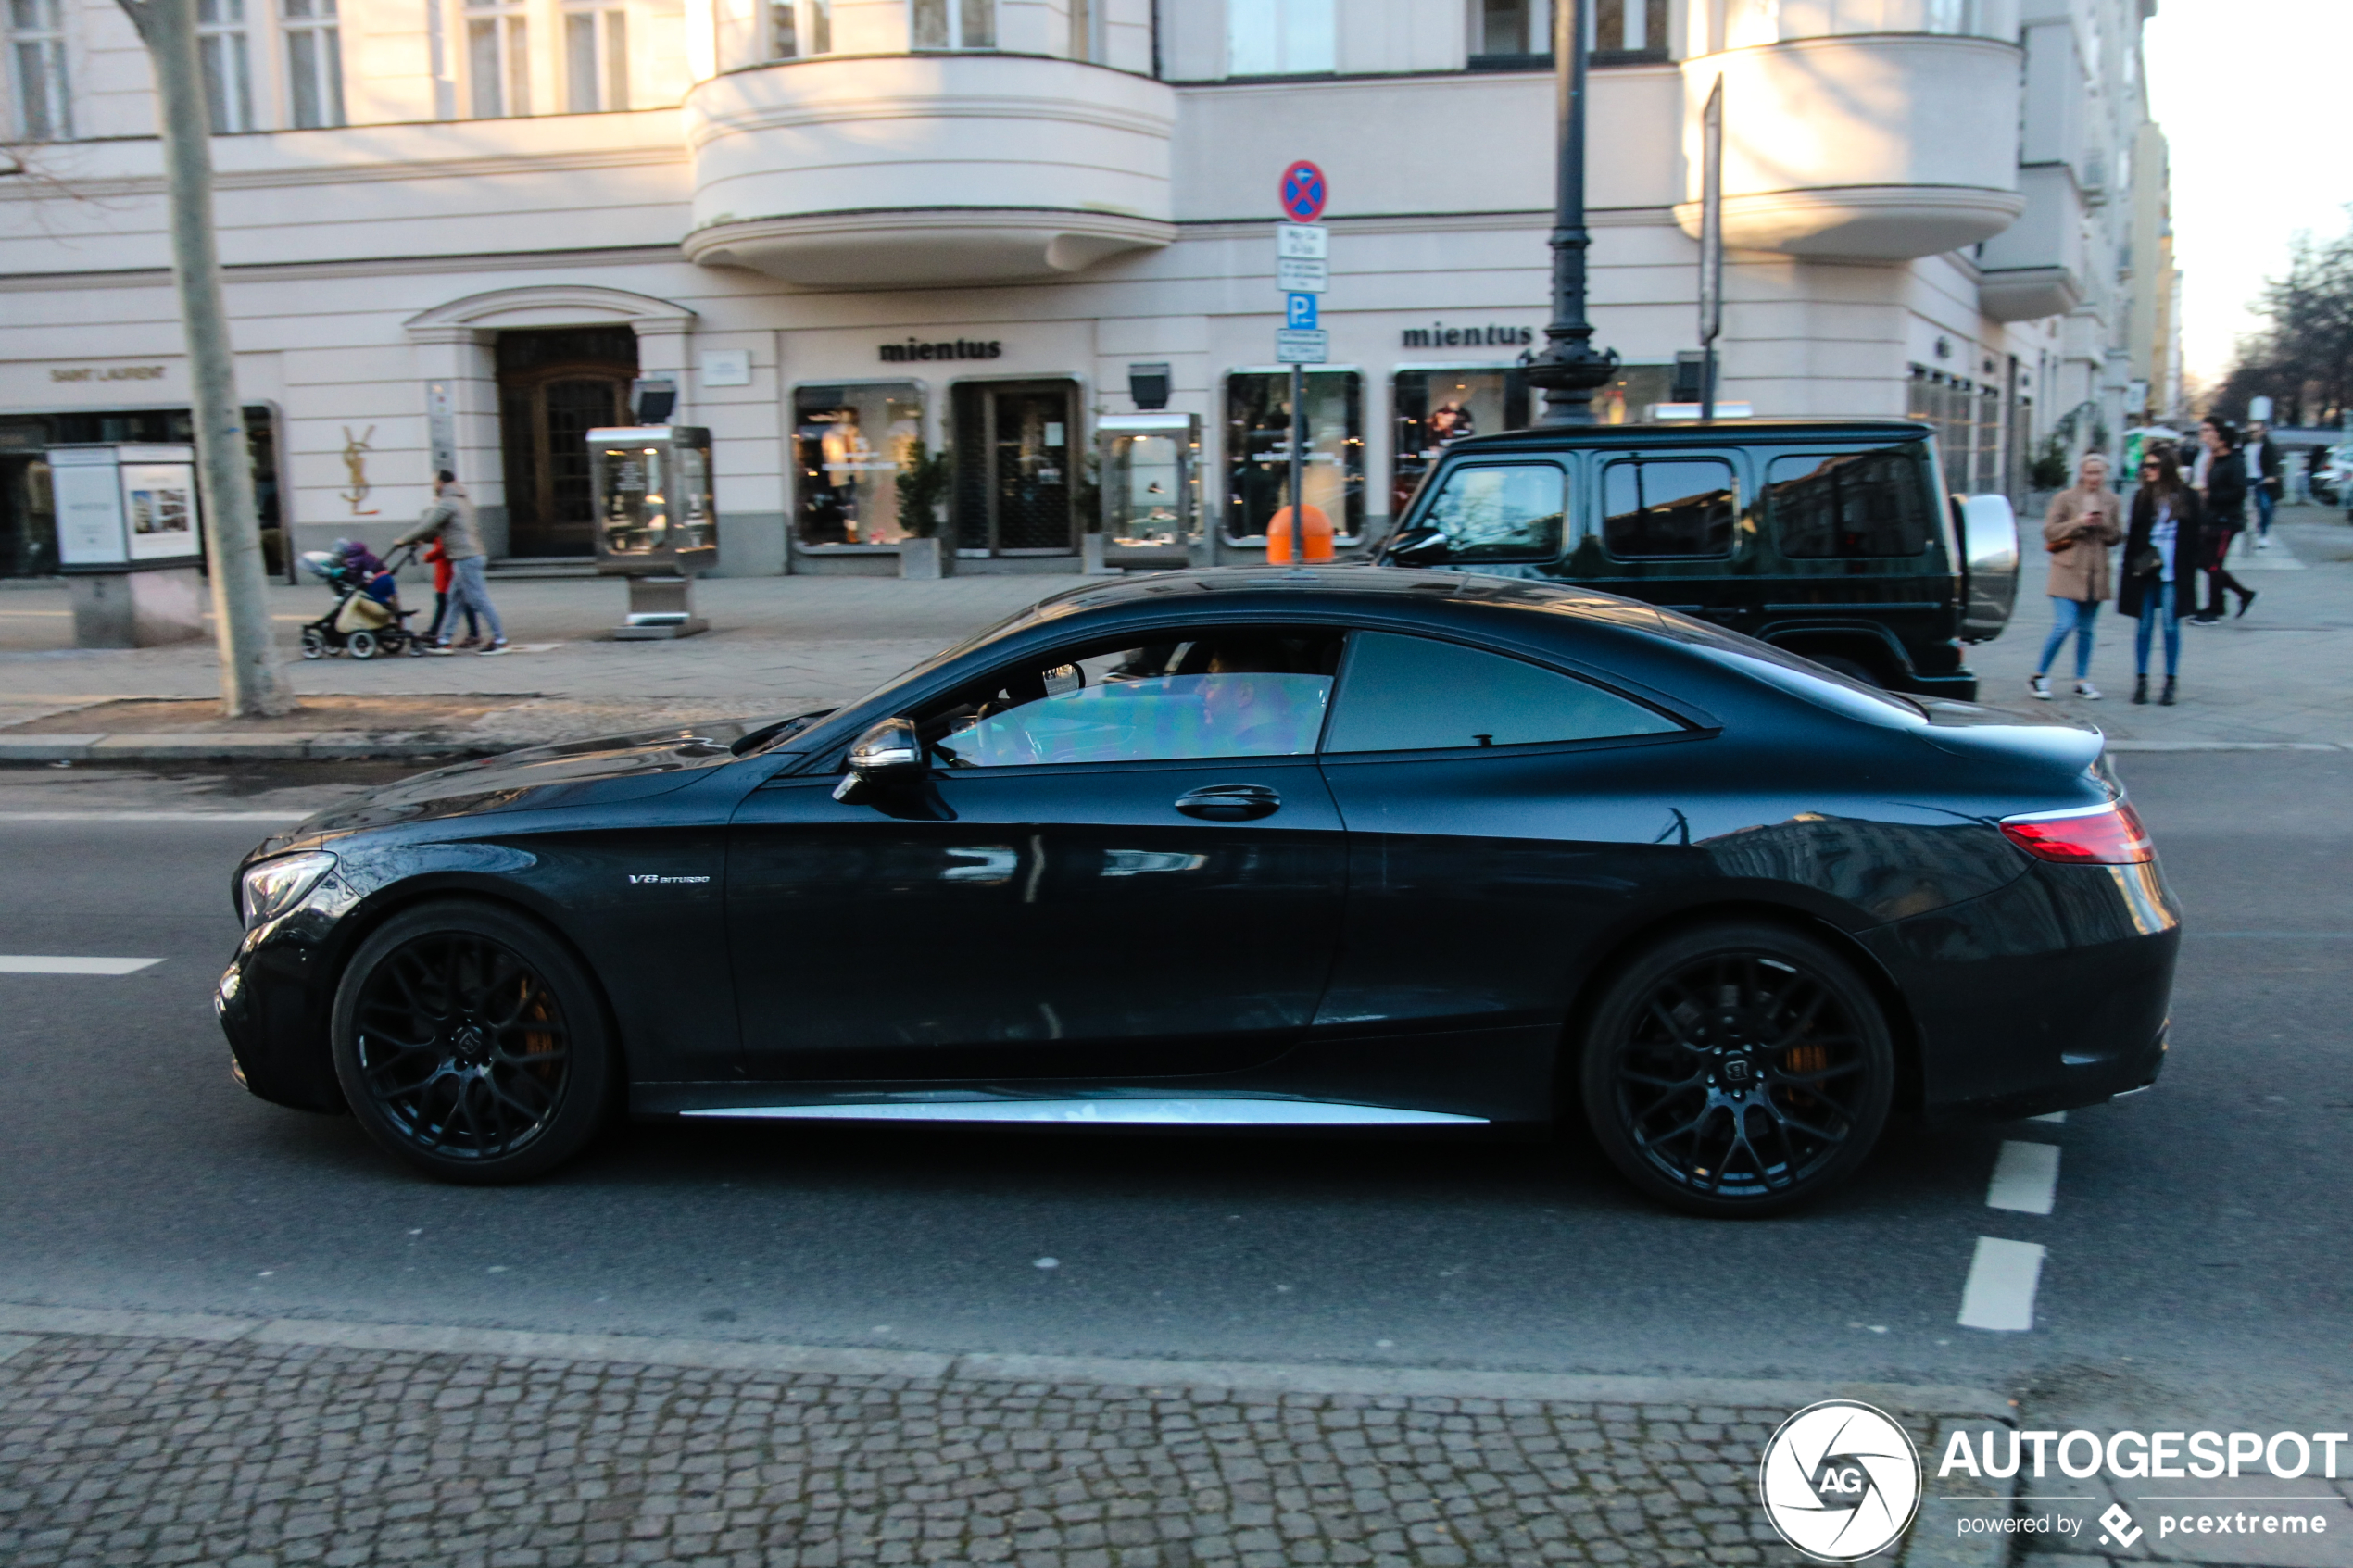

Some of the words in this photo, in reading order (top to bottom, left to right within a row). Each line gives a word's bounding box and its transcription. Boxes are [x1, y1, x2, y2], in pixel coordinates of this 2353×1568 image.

[1290, 295, 1310, 324] P
[1403, 321, 1533, 347] mientus
[878, 337, 1002, 362] mientus
[629, 874, 659, 884] V8
[660, 875, 711, 884] BITURBO
